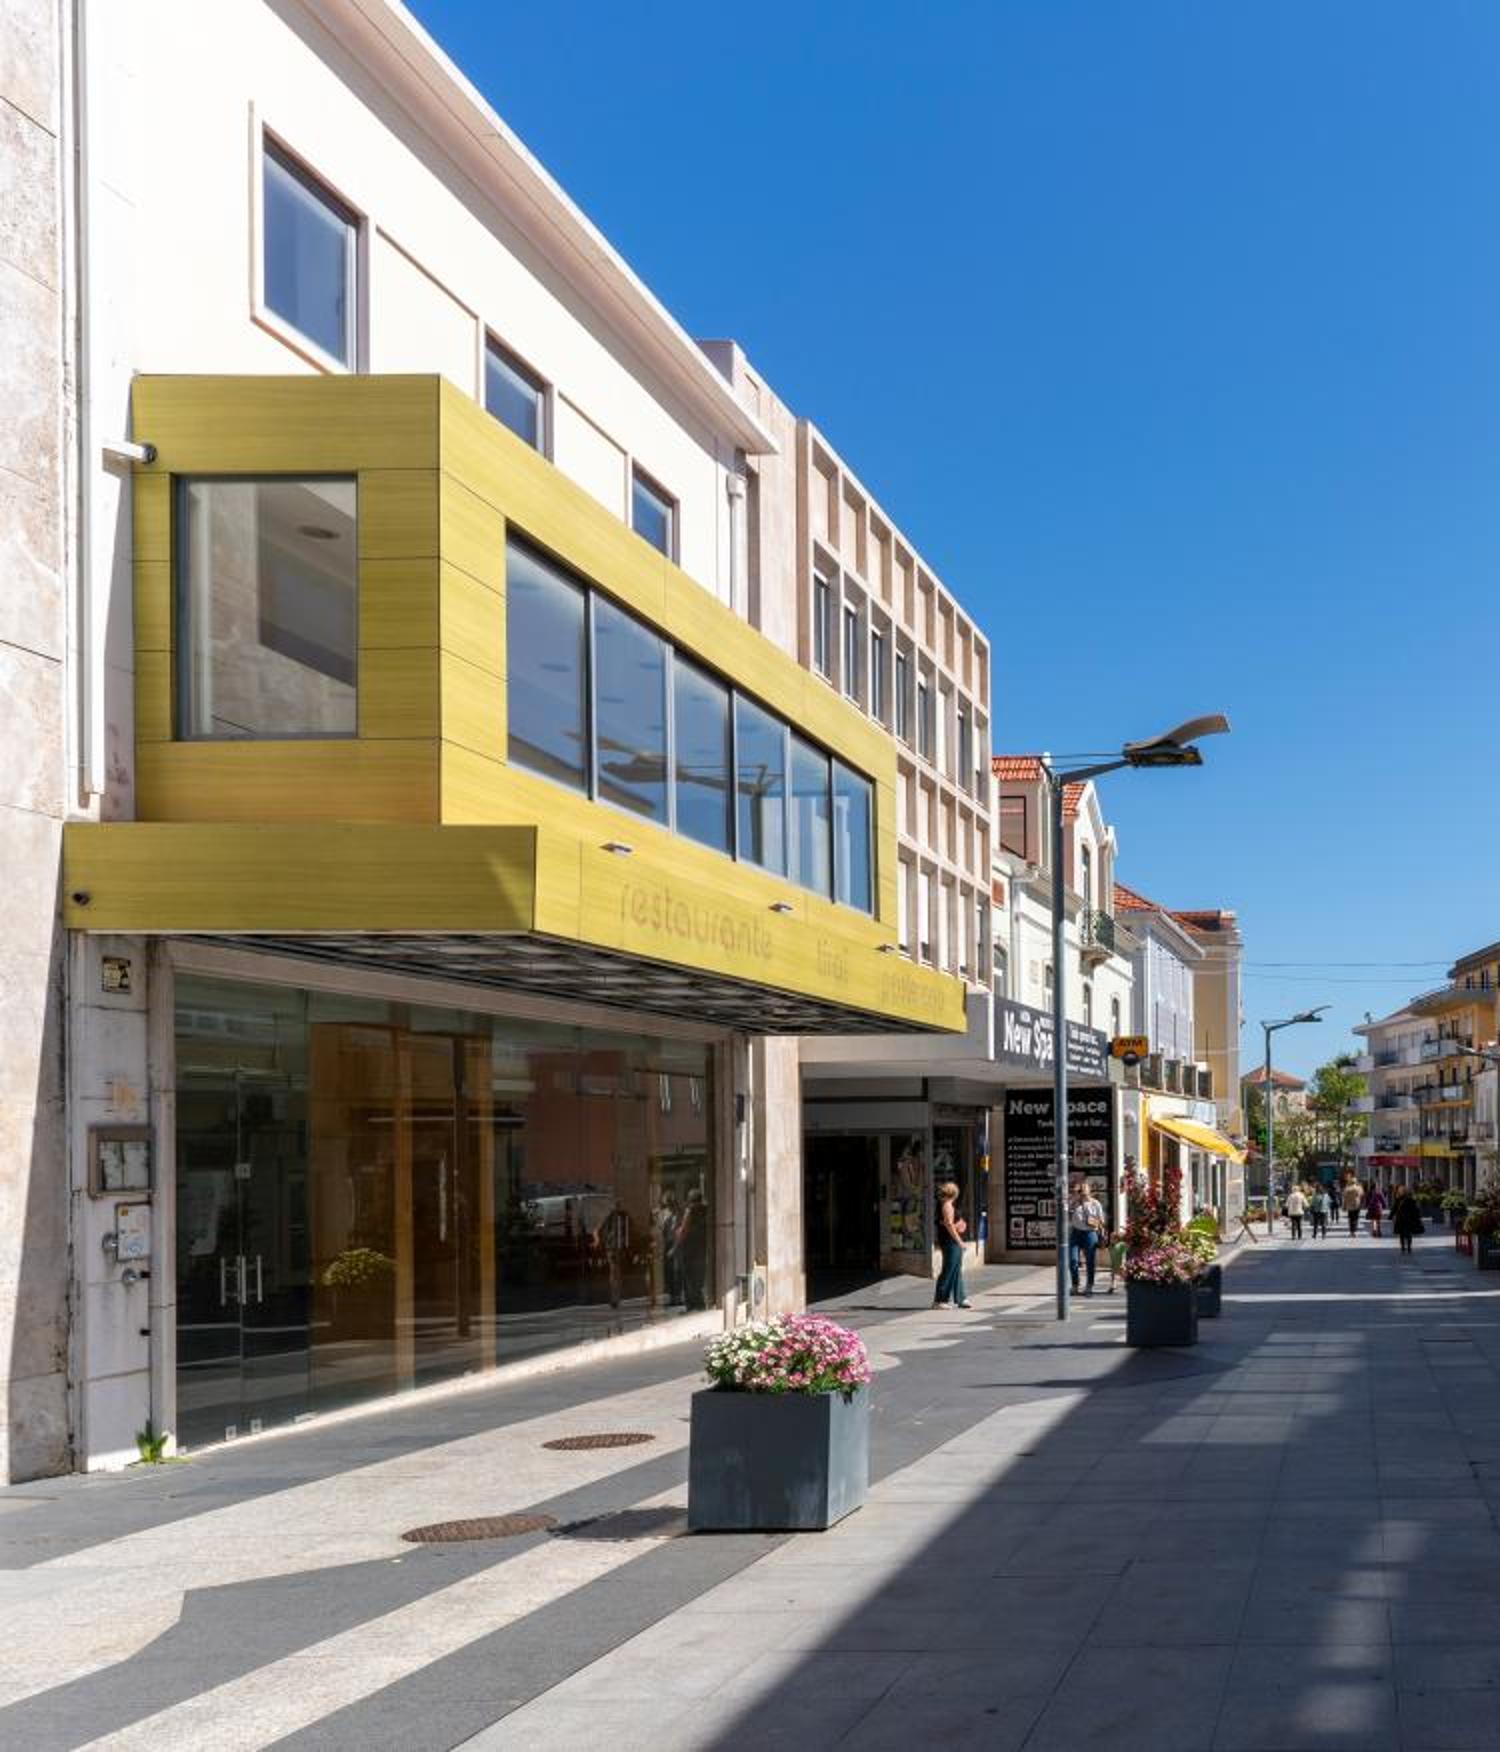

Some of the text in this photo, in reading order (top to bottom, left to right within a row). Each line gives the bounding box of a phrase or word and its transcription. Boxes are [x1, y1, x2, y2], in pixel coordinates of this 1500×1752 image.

[619, 883, 773, 959] restaurante
[1003, 1010, 1033, 1055] New
[1033, 1019, 1056, 1069] Spa
[1119, 1038, 1143, 1047] ATM
[1009, 1099, 1107, 1115] New pace
